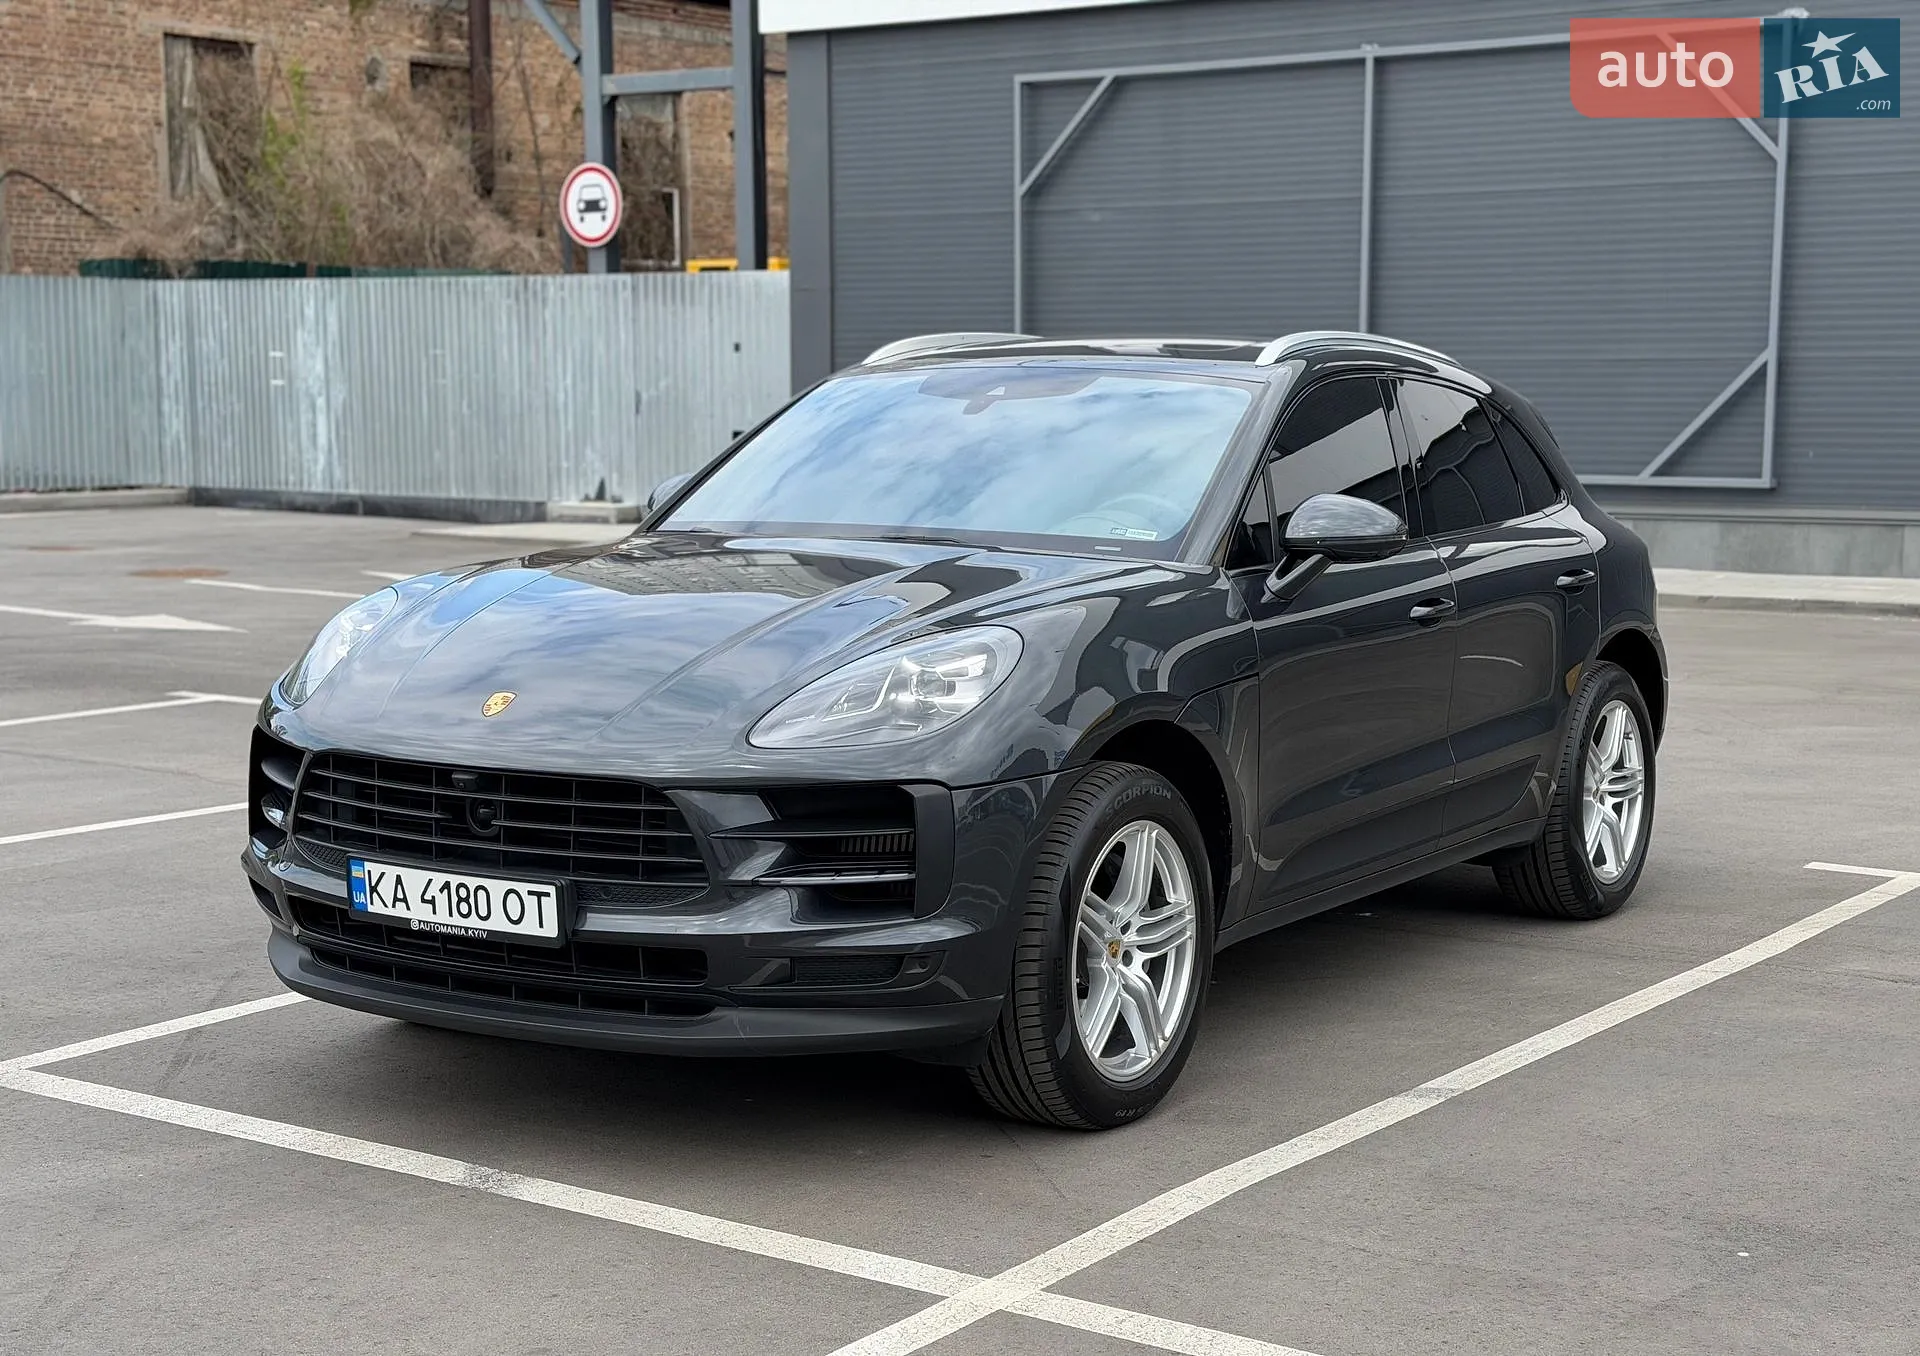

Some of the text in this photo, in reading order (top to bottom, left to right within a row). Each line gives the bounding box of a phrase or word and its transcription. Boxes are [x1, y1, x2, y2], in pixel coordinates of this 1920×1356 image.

[1104, 783, 1172, 815] SCORPION
[352, 890, 366, 904] UA
[367, 869, 551, 929] KA 4180 OT
